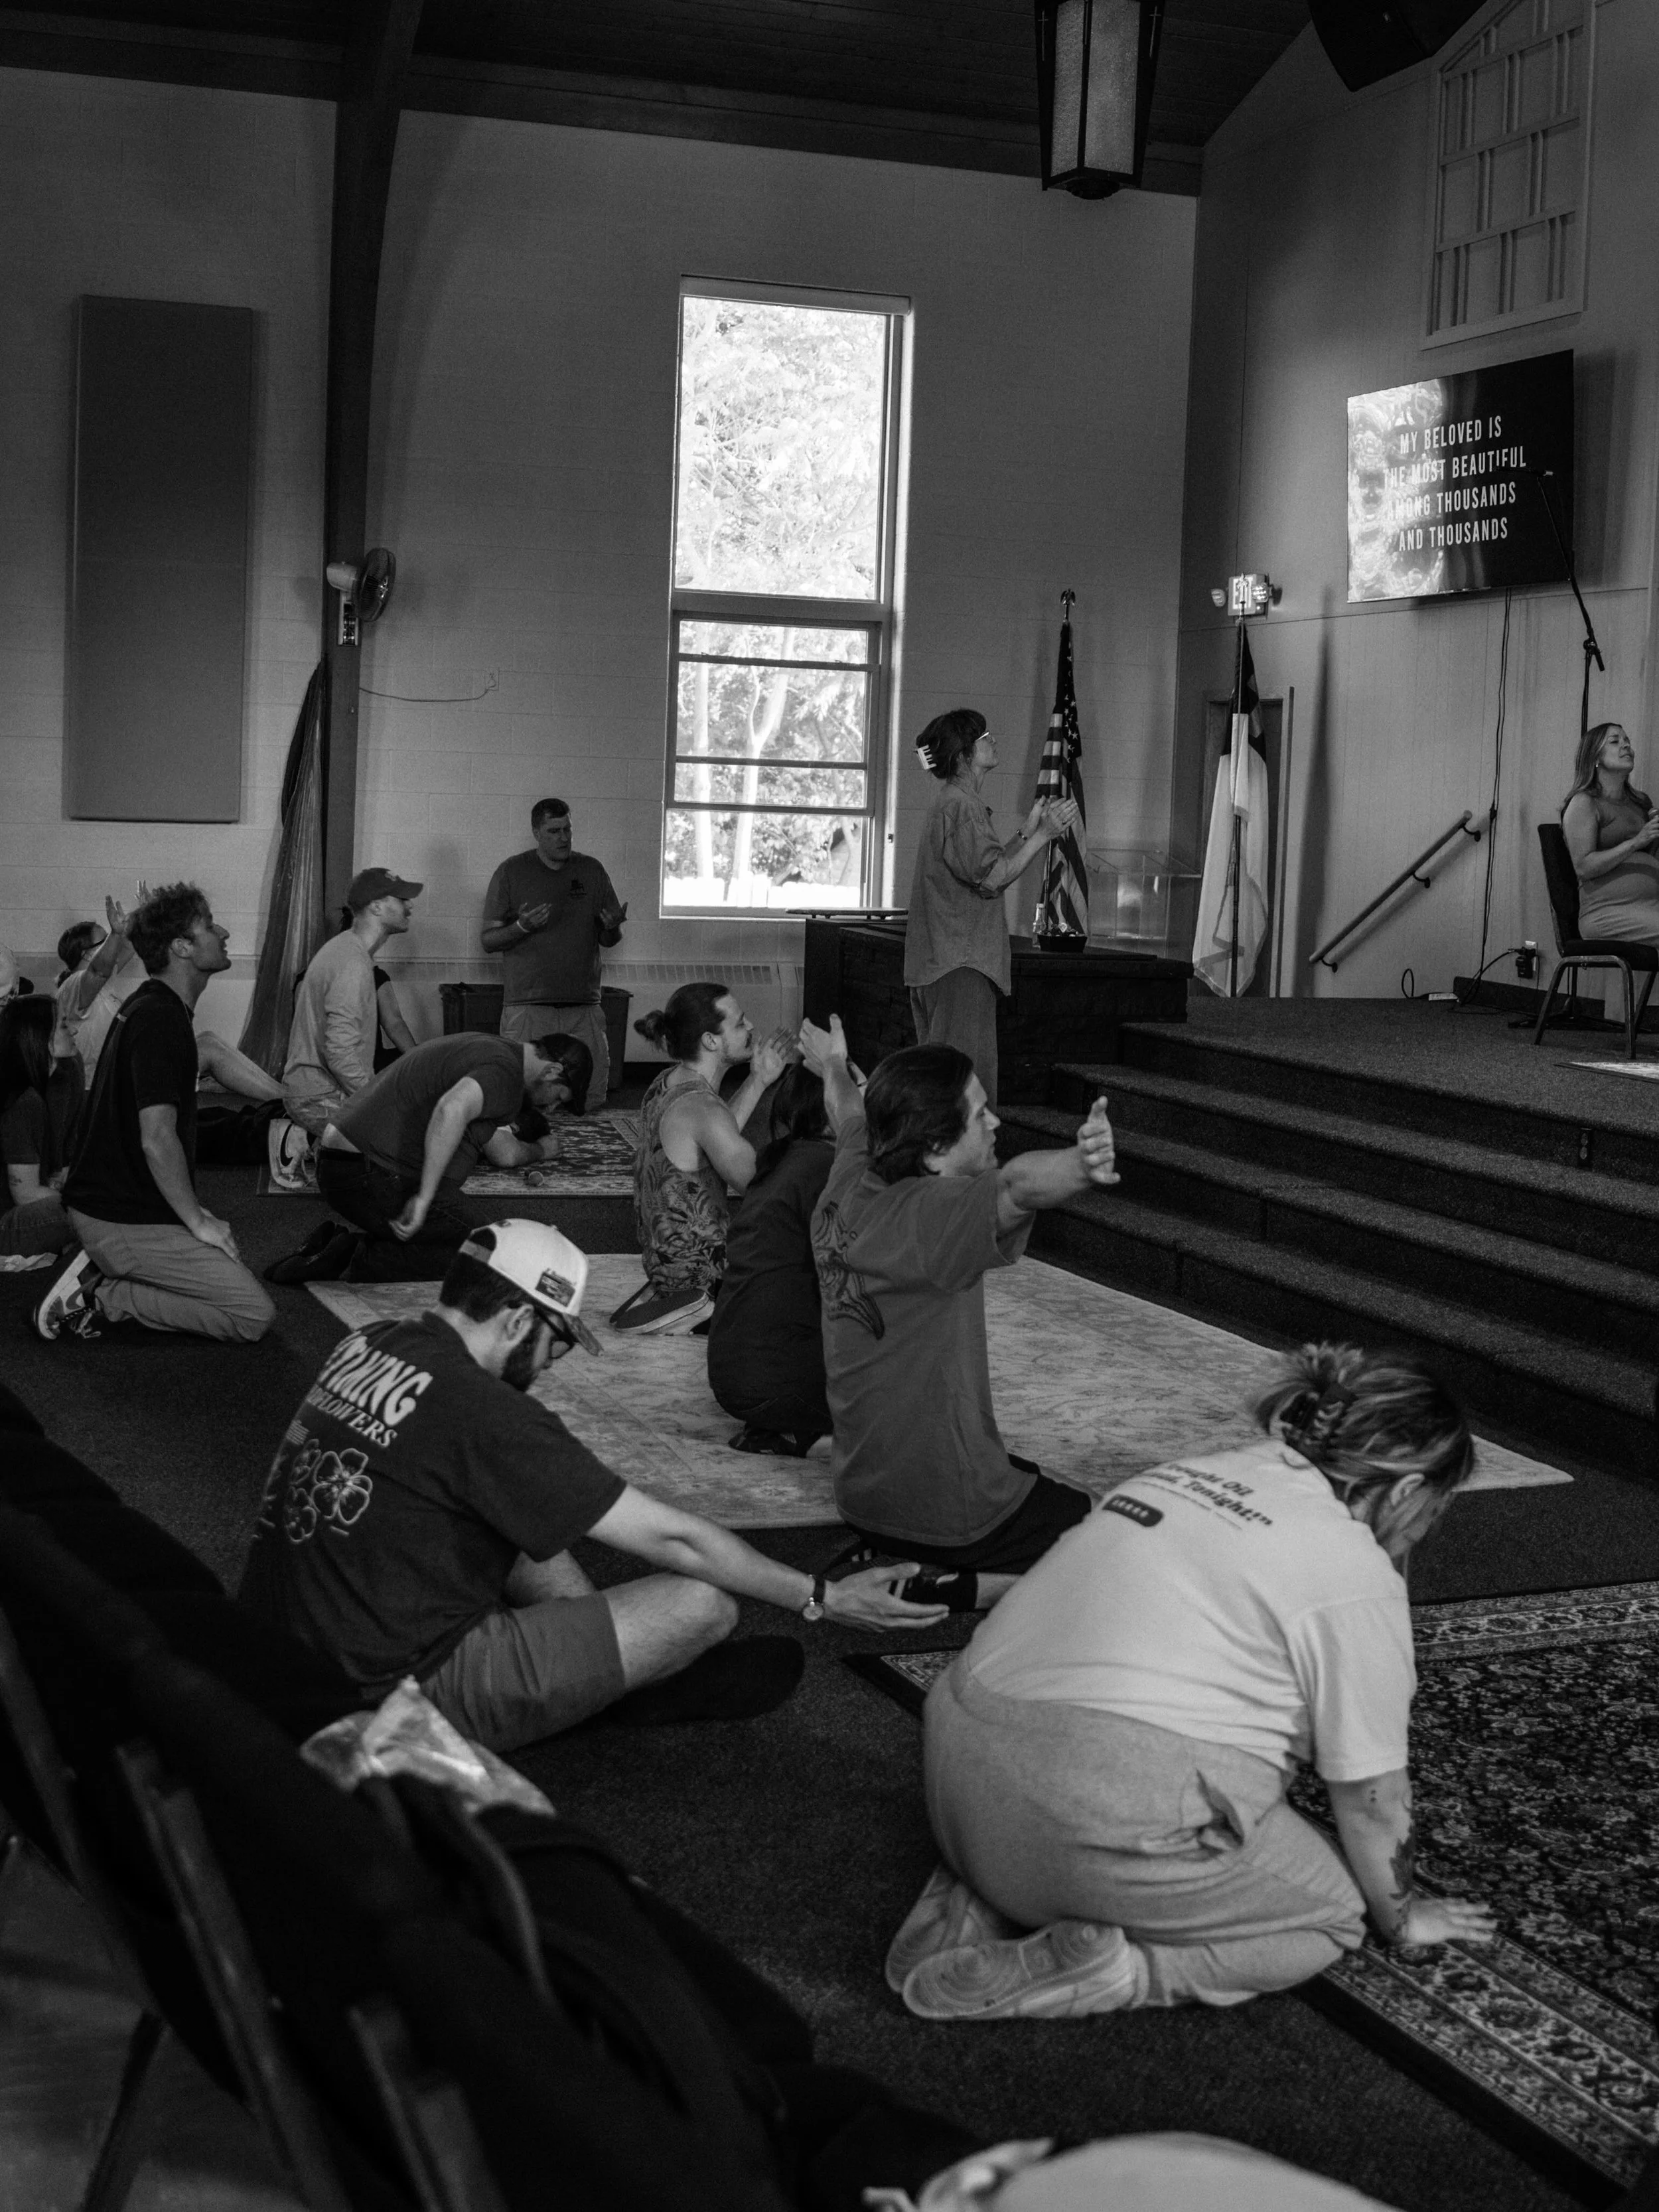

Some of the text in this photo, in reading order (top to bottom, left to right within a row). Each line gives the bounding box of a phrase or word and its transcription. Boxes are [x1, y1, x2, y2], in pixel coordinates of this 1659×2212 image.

[1400, 415, 1502, 454] MY BELOVED IS
[1383, 445, 1526, 490] THE MOST BEAUTIFUL
[1387, 481, 1516, 521] AMONG THOUSANDS
[1399, 517, 1508, 552] AND THOUSANDS
